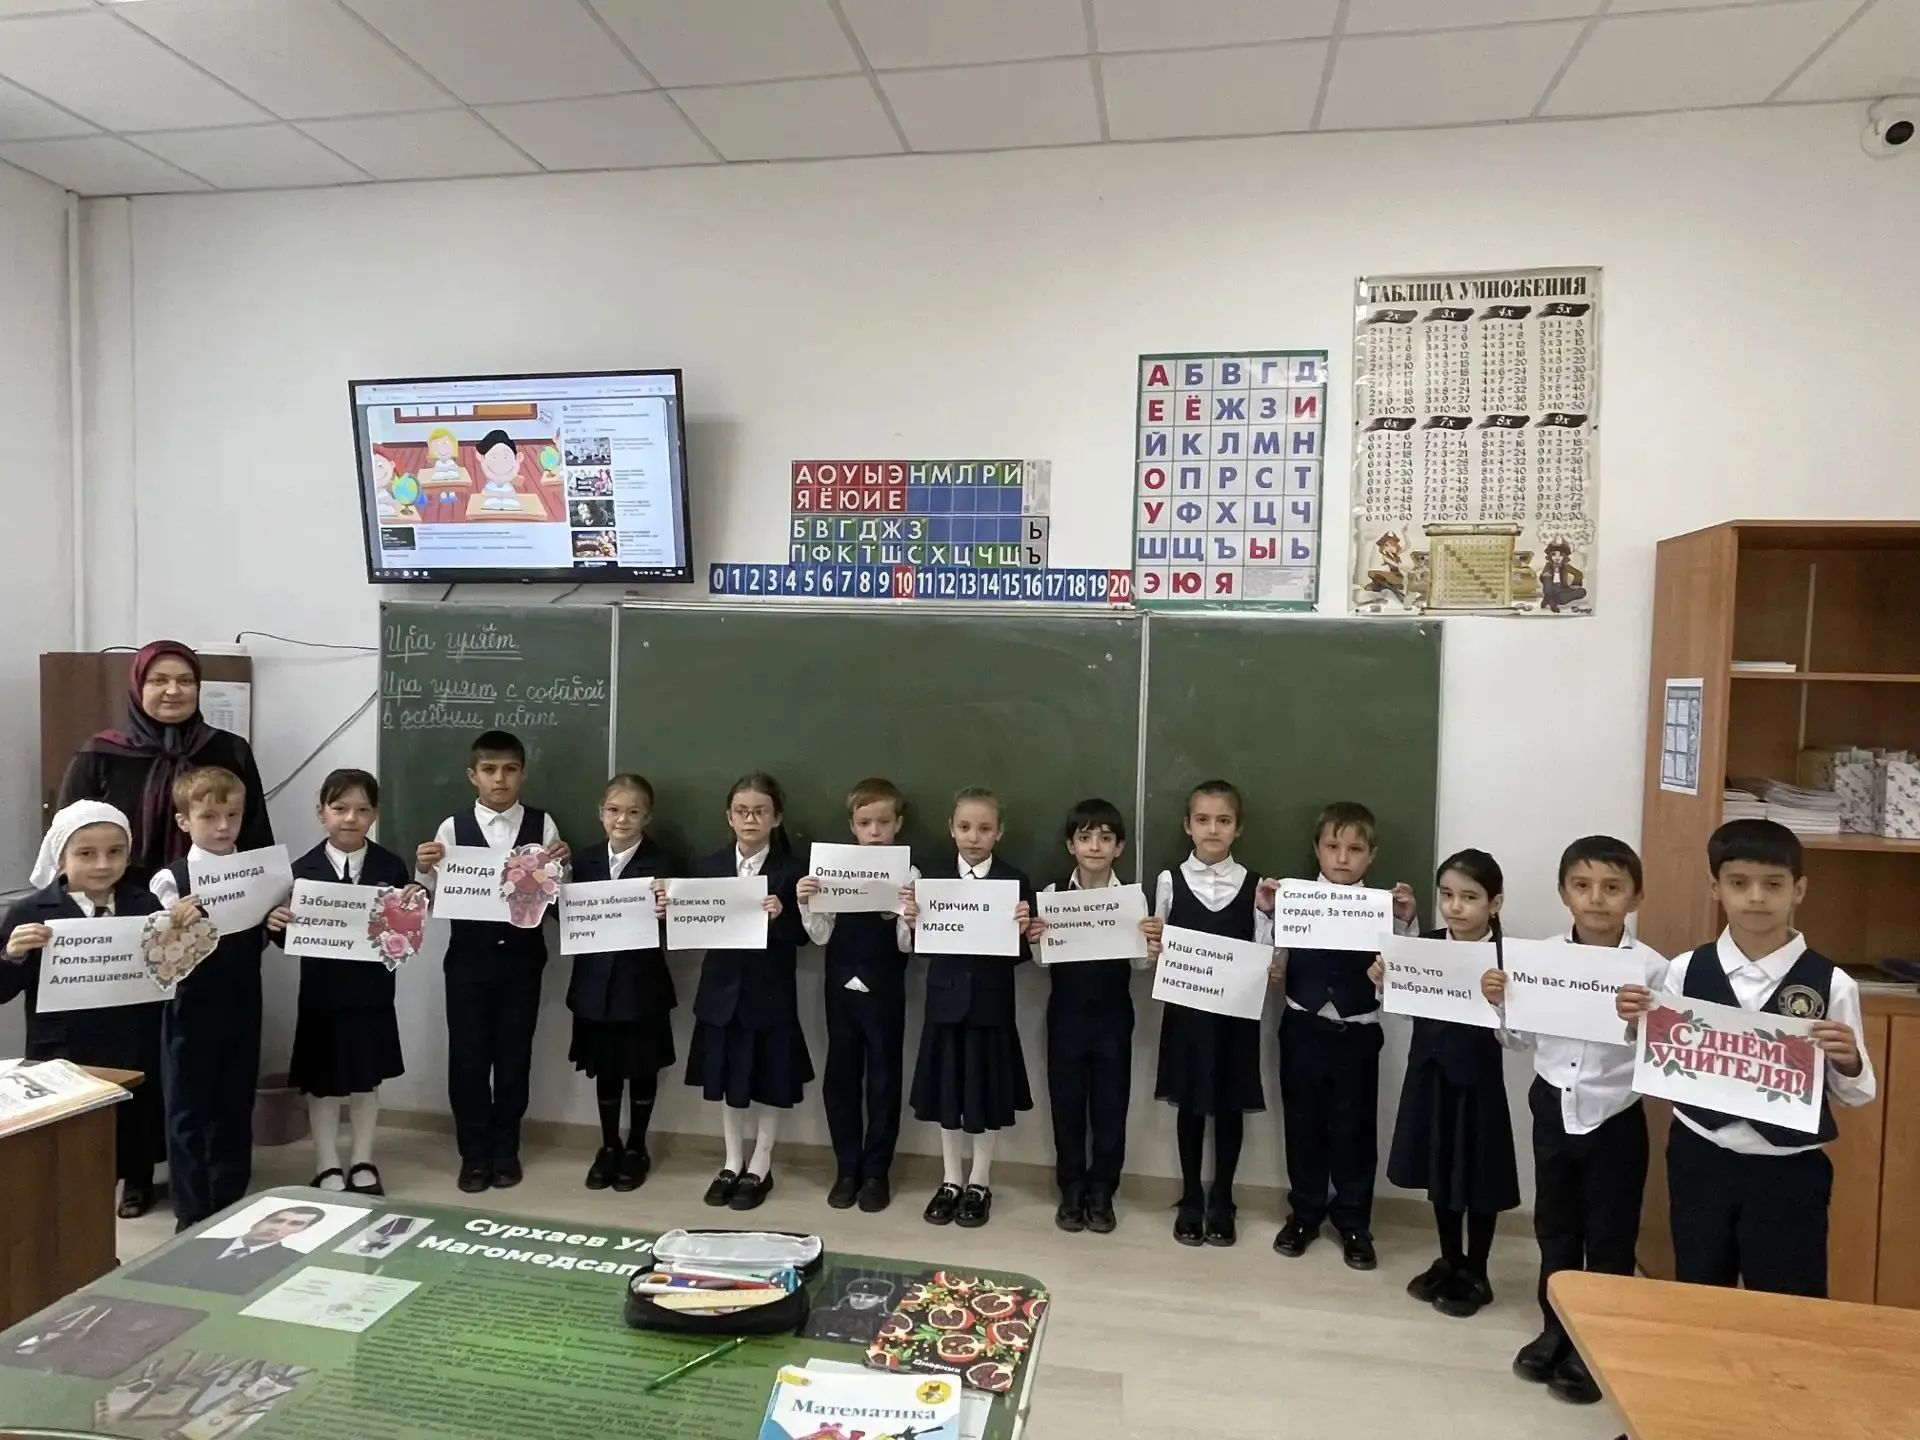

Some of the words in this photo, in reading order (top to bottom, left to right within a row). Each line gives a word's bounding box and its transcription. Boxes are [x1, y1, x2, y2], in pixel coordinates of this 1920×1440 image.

[1368, 282, 1454, 304] ТАБЛИЦА
[1459, 277, 1587, 300] УМНОЖЕНИЯ
[1148, 365, 1169, 386] А
[1185, 363, 1204, 385] Б
[1222, 363, 1241, 384] В
[1262, 362, 1278, 383] Г
[1295, 361, 1316, 382] Д
[1149, 400, 1164, 421] Е
[1186, 395, 1201, 420] Ё
[1215, 398, 1245, 419] Ж
[1260, 398, 1276, 419] З
[1295, 396, 1316, 418] И
[1145, 431, 1166, 456] Й
[1182, 433, 1202, 455] К
[1218, 432, 1239, 454] Л
[1253, 432, 1279, 454] М
[1293, 432, 1314, 454] Н
[796, 465, 812, 484] А
[818, 465, 836, 484] О
[843, 465, 858, 483] У
[865, 465, 882, 484] Ы
[888, 465, 903, 484] Э
[910, 465, 926, 484] Н
[931, 465, 951, 484] М
[956, 465, 972, 484] Л
[983, 465, 995, 484] Р
[1004, 464, 1020, 484] Й
[1145, 468, 1165, 489] О
[1180, 467, 1200, 489] П
[1219, 467, 1237, 488] Р
[1256, 467, 1272, 488] С
[1295, 467, 1311, 488] Т
[797, 490, 809, 509] Я
[821, 488, 832, 508] Ё
[840, 490, 860, 509] Ю
[864, 491, 880, 509] И
[889, 491, 901, 509] Е
[1144, 502, 1164, 523] У
[1176, 502, 1201, 523] Ф
[1216, 502, 1237, 523] Х
[1253, 502, 1276, 525] Ц
[1292, 501, 1310, 523] Ч
[794, 520, 805, 538] Б
[816, 520, 828, 538] В
[841, 520, 851, 538] Г
[859, 521, 877, 541] Д
[1138, 538, 1167, 559] Ш
[1173, 538, 1204, 561] Щ
[1214, 538, 1236, 559] Ъ
[1250, 538, 1276, 559] Ы
[1292, 538, 1310, 559] Ь
[714, 569, 724, 589] 0
[733, 569, 740, 589] 1
[750, 569, 759, 590] 2
[768, 569, 777, 590] 3
[786, 570, 796, 591] 4
[804, 570, 814, 591] 5
[823, 570, 833, 592] 6
[842, 571, 852, 592] 7
[860, 571, 870, 592] 8
[879, 572, 889, 592] 9
[896, 569, 912, 594] 10
[917, 572, 932, 593] 11
[938, 573, 955, 594] 12
[960, 573, 976, 594] 13
[981, 573, 999, 595] 14
[1003, 574, 1020, 595] 15
[1024, 574, 1041, 596] 16
[1046, 574, 1064, 596] 17
[1067, 574, 1085, 596] 18
[1089, 575, 1107, 596] 19
[1110, 575, 1129, 597] 20
[1144, 573, 1160, 593] Э
[1172, 573, 1201, 594] Ю
[1216, 573, 1232, 594] Я
[506, 684, 517, 697] с
[198, 875, 221, 886] Мы
[224, 864, 265, 882] иногда
[446, 863, 495, 877] Иногда
[816, 867, 890, 880] Опаздываем
[199, 890, 245, 907] шумим
[443, 886, 491, 896] шалим
[1283, 891, 1327, 900] Спасибо
[1355, 893, 1367, 901] за
[299, 895, 367, 910] Забываем
[566, 899, 599, 908] Иногда
[601, 895, 646, 904] забываем
[672, 898, 710, 906] Бежим
[929, 900, 979, 912] Кричим
[983, 904, 990, 912] в
[1045, 905, 1060, 914] Но
[1084, 901, 1120, 912] всегда
[567, 912, 603, 923] тетради
[605, 911, 622, 919] или
[674, 915, 725, 924] коридору
[1327, 908, 1340, 917] За
[1343, 910, 1374, 919] тепло
[295, 917, 347, 928] сделать
[922, 922, 964, 932] классе
[1098, 919, 1115, 927] что
[54, 935, 112, 948] Дорогая
[293, 935, 354, 949] домашку
[569, 930, 596, 939] ручку
[52, 952, 134, 965] Гюльзарият
[1168, 940, 1192, 954] Наш
[1196, 948, 1234, 962] самый
[1165, 960, 1213, 976] главный
[1388, 962, 1401, 972] За
[1404, 965, 1420, 976] то,
[1423, 968, 1443, 977] что
[1162, 977, 1224, 997] наставник!
[1513, 971, 1538, 984] Мы
[1542, 976, 1565, 987] вас
[1391, 983, 1443, 996] выбрали
[1447, 989, 1471, 1000] нас!
[1670, 1023, 1692, 1046] С
[1703, 1029, 1786, 1063] ДНЁМ
[1651, 1043, 1805, 1096] УЧИТЕЛЯ!
[464, 1219, 608, 1247] Сурхаев
[791, 1399, 936, 1420] Математика
